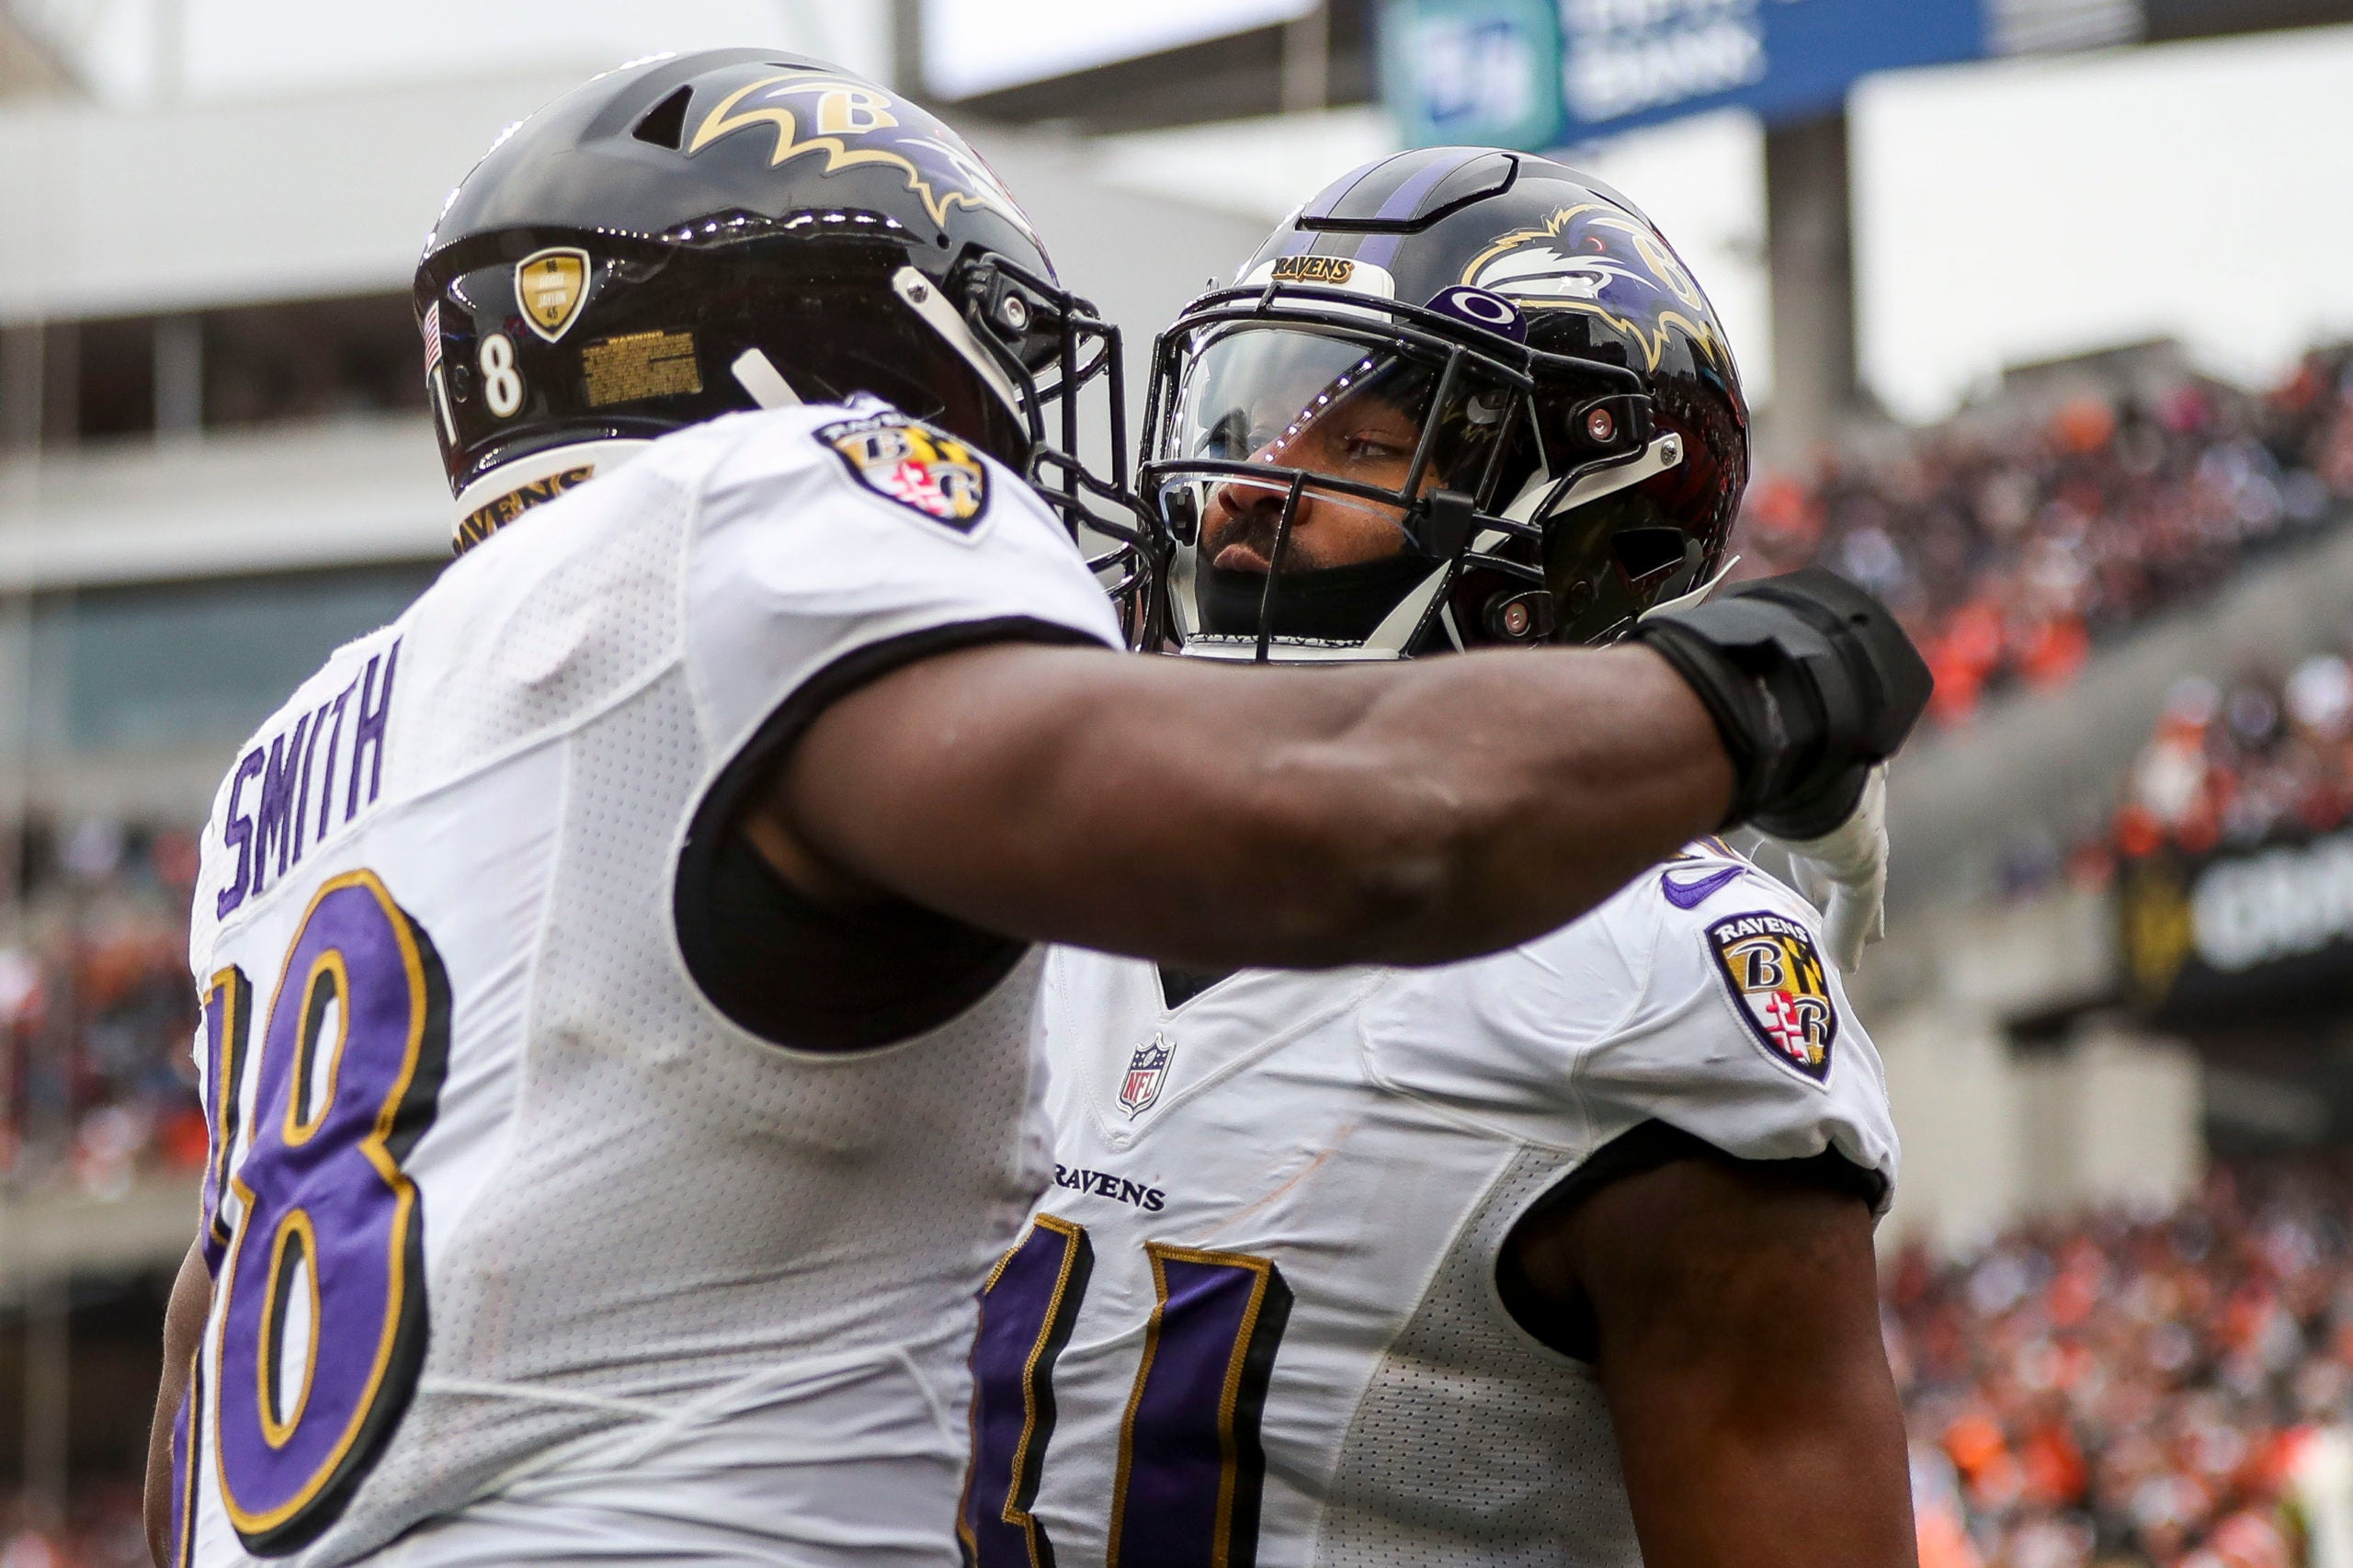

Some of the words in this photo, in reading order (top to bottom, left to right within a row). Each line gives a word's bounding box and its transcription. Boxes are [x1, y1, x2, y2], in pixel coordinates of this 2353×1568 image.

[1271, 256, 1355, 284] RAVENS
[217, 634, 404, 922] SMITH
[1713, 917, 1810, 946] RAVENS
[1123, 1071, 1156, 1104] NFL
[1054, 1163, 1166, 1212] RAVENS
